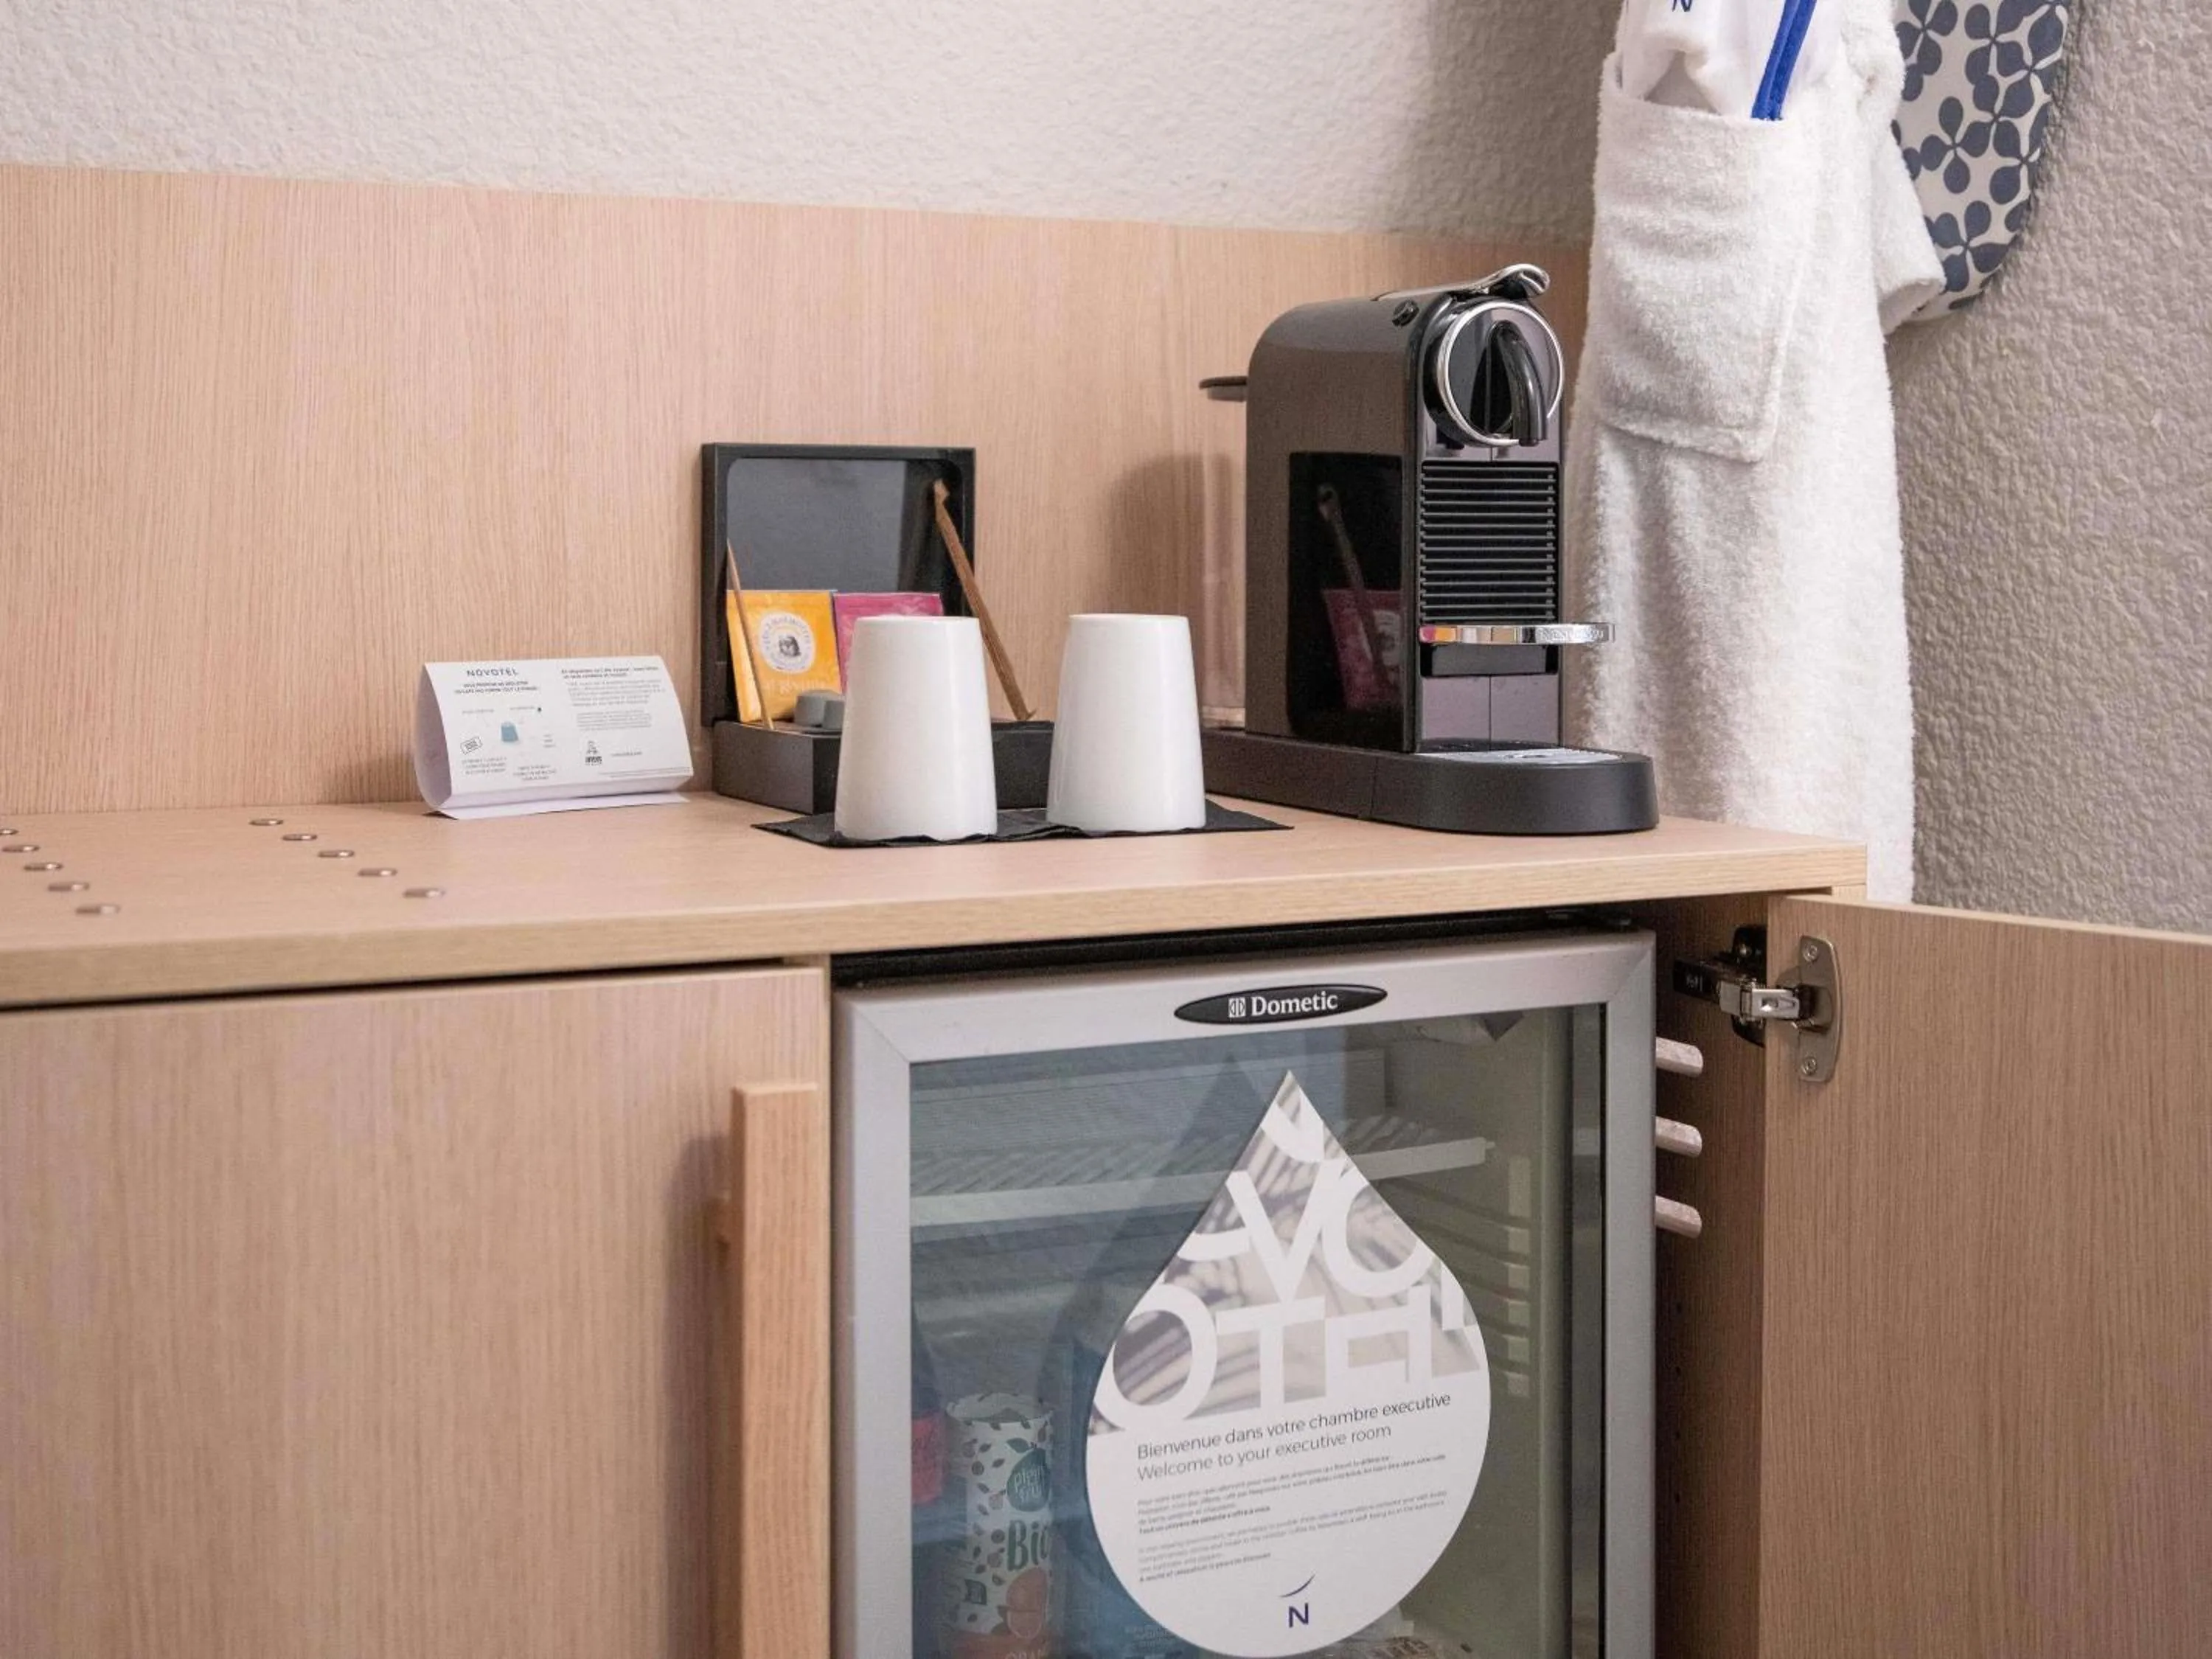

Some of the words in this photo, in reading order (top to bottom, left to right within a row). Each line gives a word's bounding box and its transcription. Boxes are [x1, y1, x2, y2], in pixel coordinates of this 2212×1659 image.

[466, 667, 519, 677] NOVOTEL
[1251, 990, 1338, 1017] Dometic
[1137, 1433, 1222, 1461] Bienvenue
[1225, 1427, 1263, 1444] dans
[1266, 1419, 1306, 1437] votre
[1309, 1407, 1379, 1429] chambre
[1382, 1392, 1452, 1416] executive
[1137, 1457, 1214, 1481] Welcome
[1217, 1454, 1234, 1467] to
[1237, 1447, 1270, 1467] your
[1275, 1433, 1348, 1457] executive
[1351, 1425, 1392, 1444] room
[1288, 1602, 1309, 1628] N
